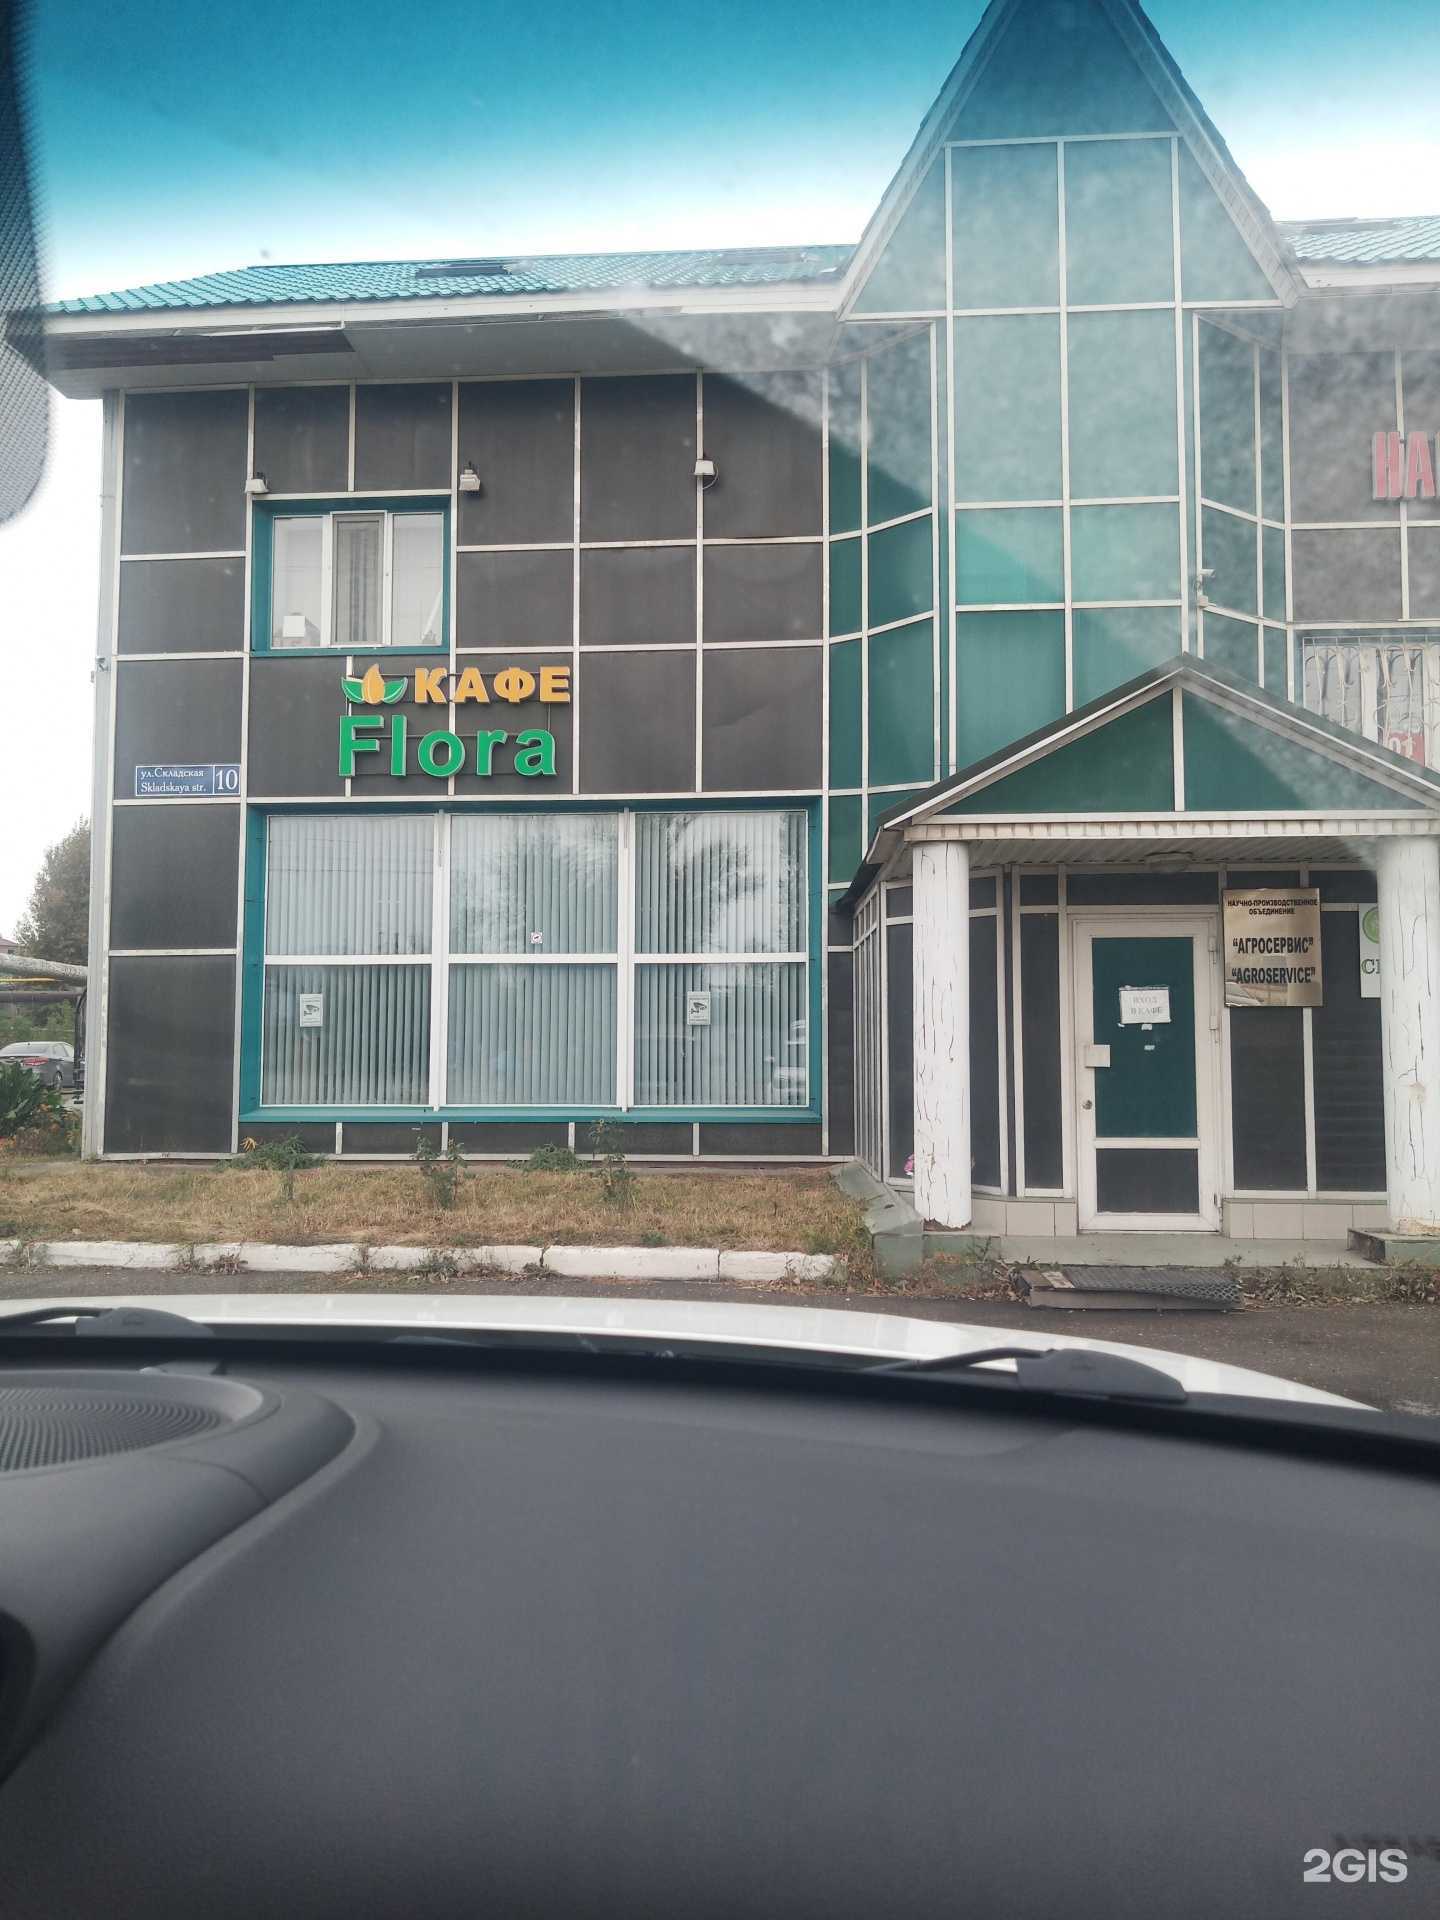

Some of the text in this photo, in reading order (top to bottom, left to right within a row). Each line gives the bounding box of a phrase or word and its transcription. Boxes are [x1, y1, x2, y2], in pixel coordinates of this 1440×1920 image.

[1372, 431, 1440, 500] НА
[414, 665, 571, 704] КАФЕ
[339, 714, 557, 777] Flora
[140, 781, 207, 794] Skladskaya str.
[215, 769, 238, 790] 10
[1227, 899, 1318, 907] НАУЧНО-ПРОИЗВОДСТВЕННОЕ
[1248, 907, 1296, 916] ОБЪЕДИНЕНИЕ
[1232, 937, 1314, 954] “АГРОСЕРВИС”
[1231, 967, 1316, 984] “AGROSERVICE”
